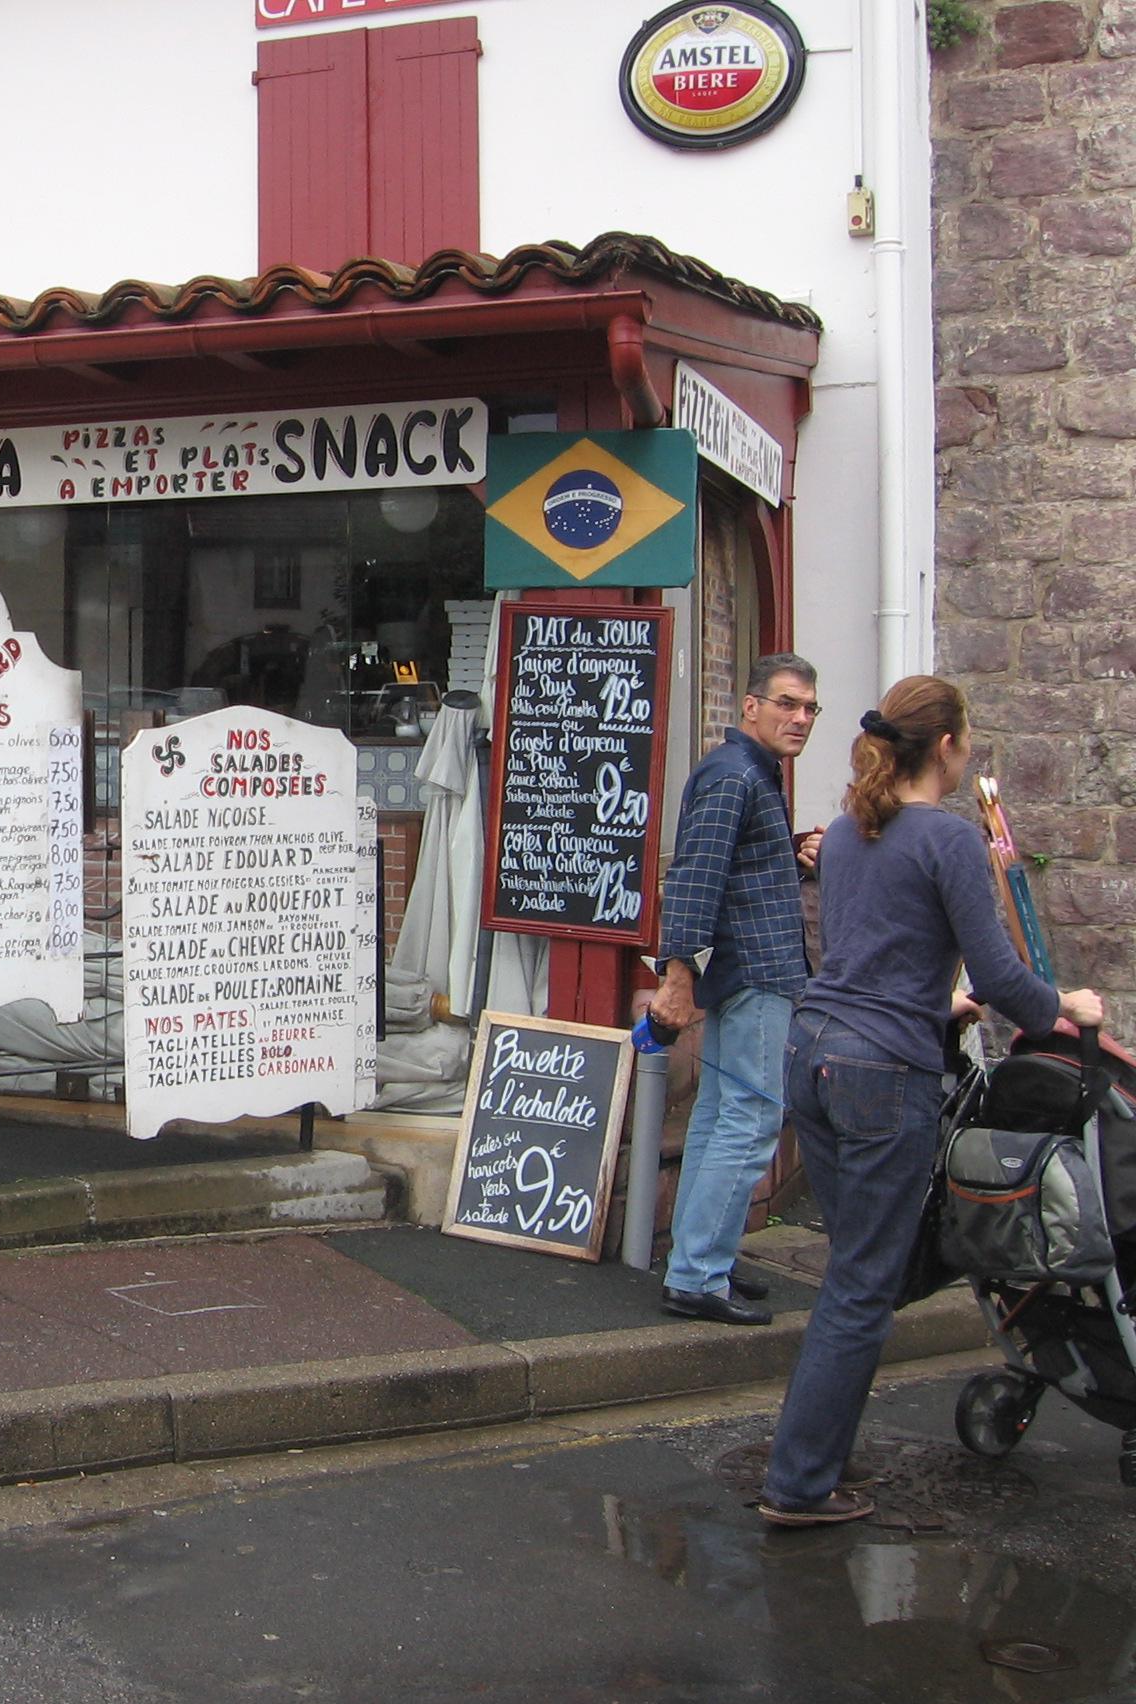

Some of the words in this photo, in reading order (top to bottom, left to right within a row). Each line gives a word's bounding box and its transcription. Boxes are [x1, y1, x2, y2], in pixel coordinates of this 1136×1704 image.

[659, 45, 757, 70] AMSTEL
[674, 72, 738, 91] BIERE
[268, 405, 476, 484] SNACK
[125, 448, 159, 473] ET
[180, 442, 270, 470] PLATS
[60, 479, 76, 500] A
[92, 469, 249, 498] EMPORTER
[524, 615, 573, 647] PLAT
[570, 621, 594, 646] du
[597, 619, 651, 647] JOUR
[515, 678, 536, 698] du
[225, 728, 272, 751] NOS
[509, 727, 554, 757] Gigot
[211, 753, 304, 775] SALADES
[144, 808, 200, 830] SALADE
[150, 851, 216, 874] SALADE
[224, 848, 313, 870] EDOUARD
[500, 848, 520, 871] du
[151, 894, 220, 919] SALADE
[225, 901, 243, 914] AU
[247, 887, 345, 914] ROQUEFORT
[147, 939, 209, 962] SALADE
[291, 930, 347, 953] CHAUD
[141, 982, 196, 1007] SALADE
[197, 993, 211, 1002] DE
[214, 978, 269, 1001] POULET
[145, 1015, 184, 1038] NOS
[271, 1027, 316, 1043] BEURRE
[257, 1056, 336, 1077] CARBONARA
[489, 1029, 585, 1081] Bavette
